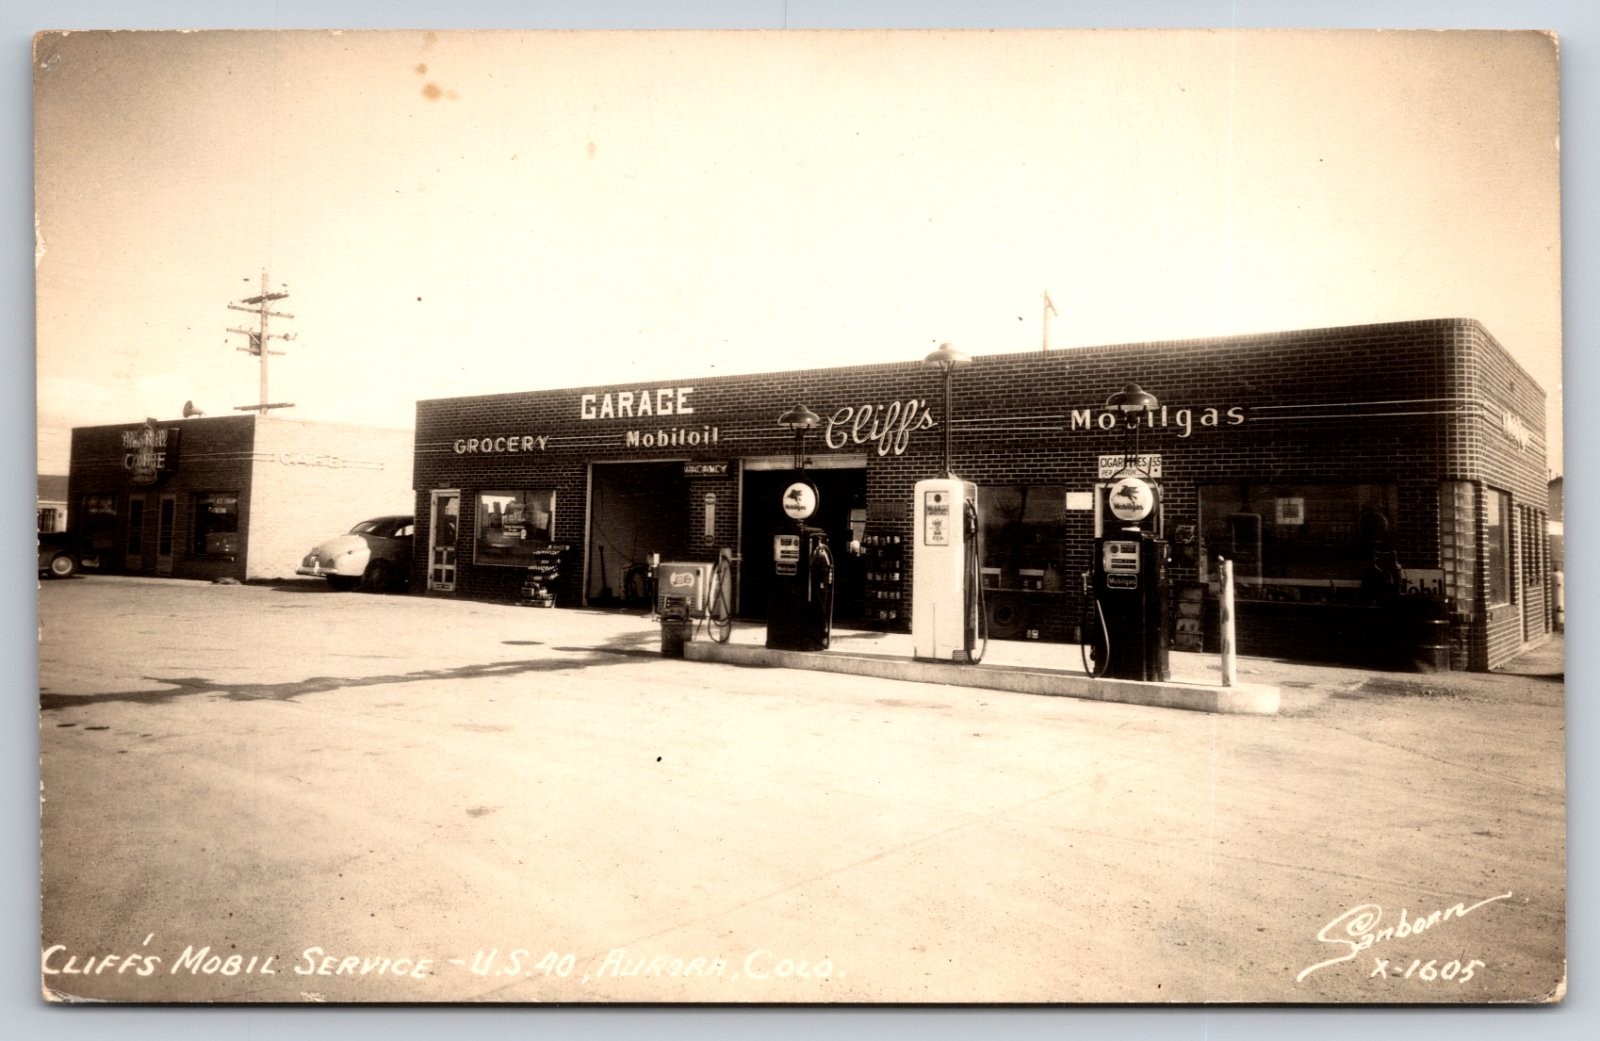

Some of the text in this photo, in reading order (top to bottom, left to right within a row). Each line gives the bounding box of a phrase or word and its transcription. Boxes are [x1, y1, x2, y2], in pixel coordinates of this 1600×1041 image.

[580, 386, 694, 420] GARAGE
[625, 425, 720, 448] Mobiloil
[825, 398, 939, 457] Cliff's
[453, 434, 549, 455] GROCERY
[1100, 456, 1147, 468] CIGARES
[1113, 502, 1144, 513] Mobilgas
